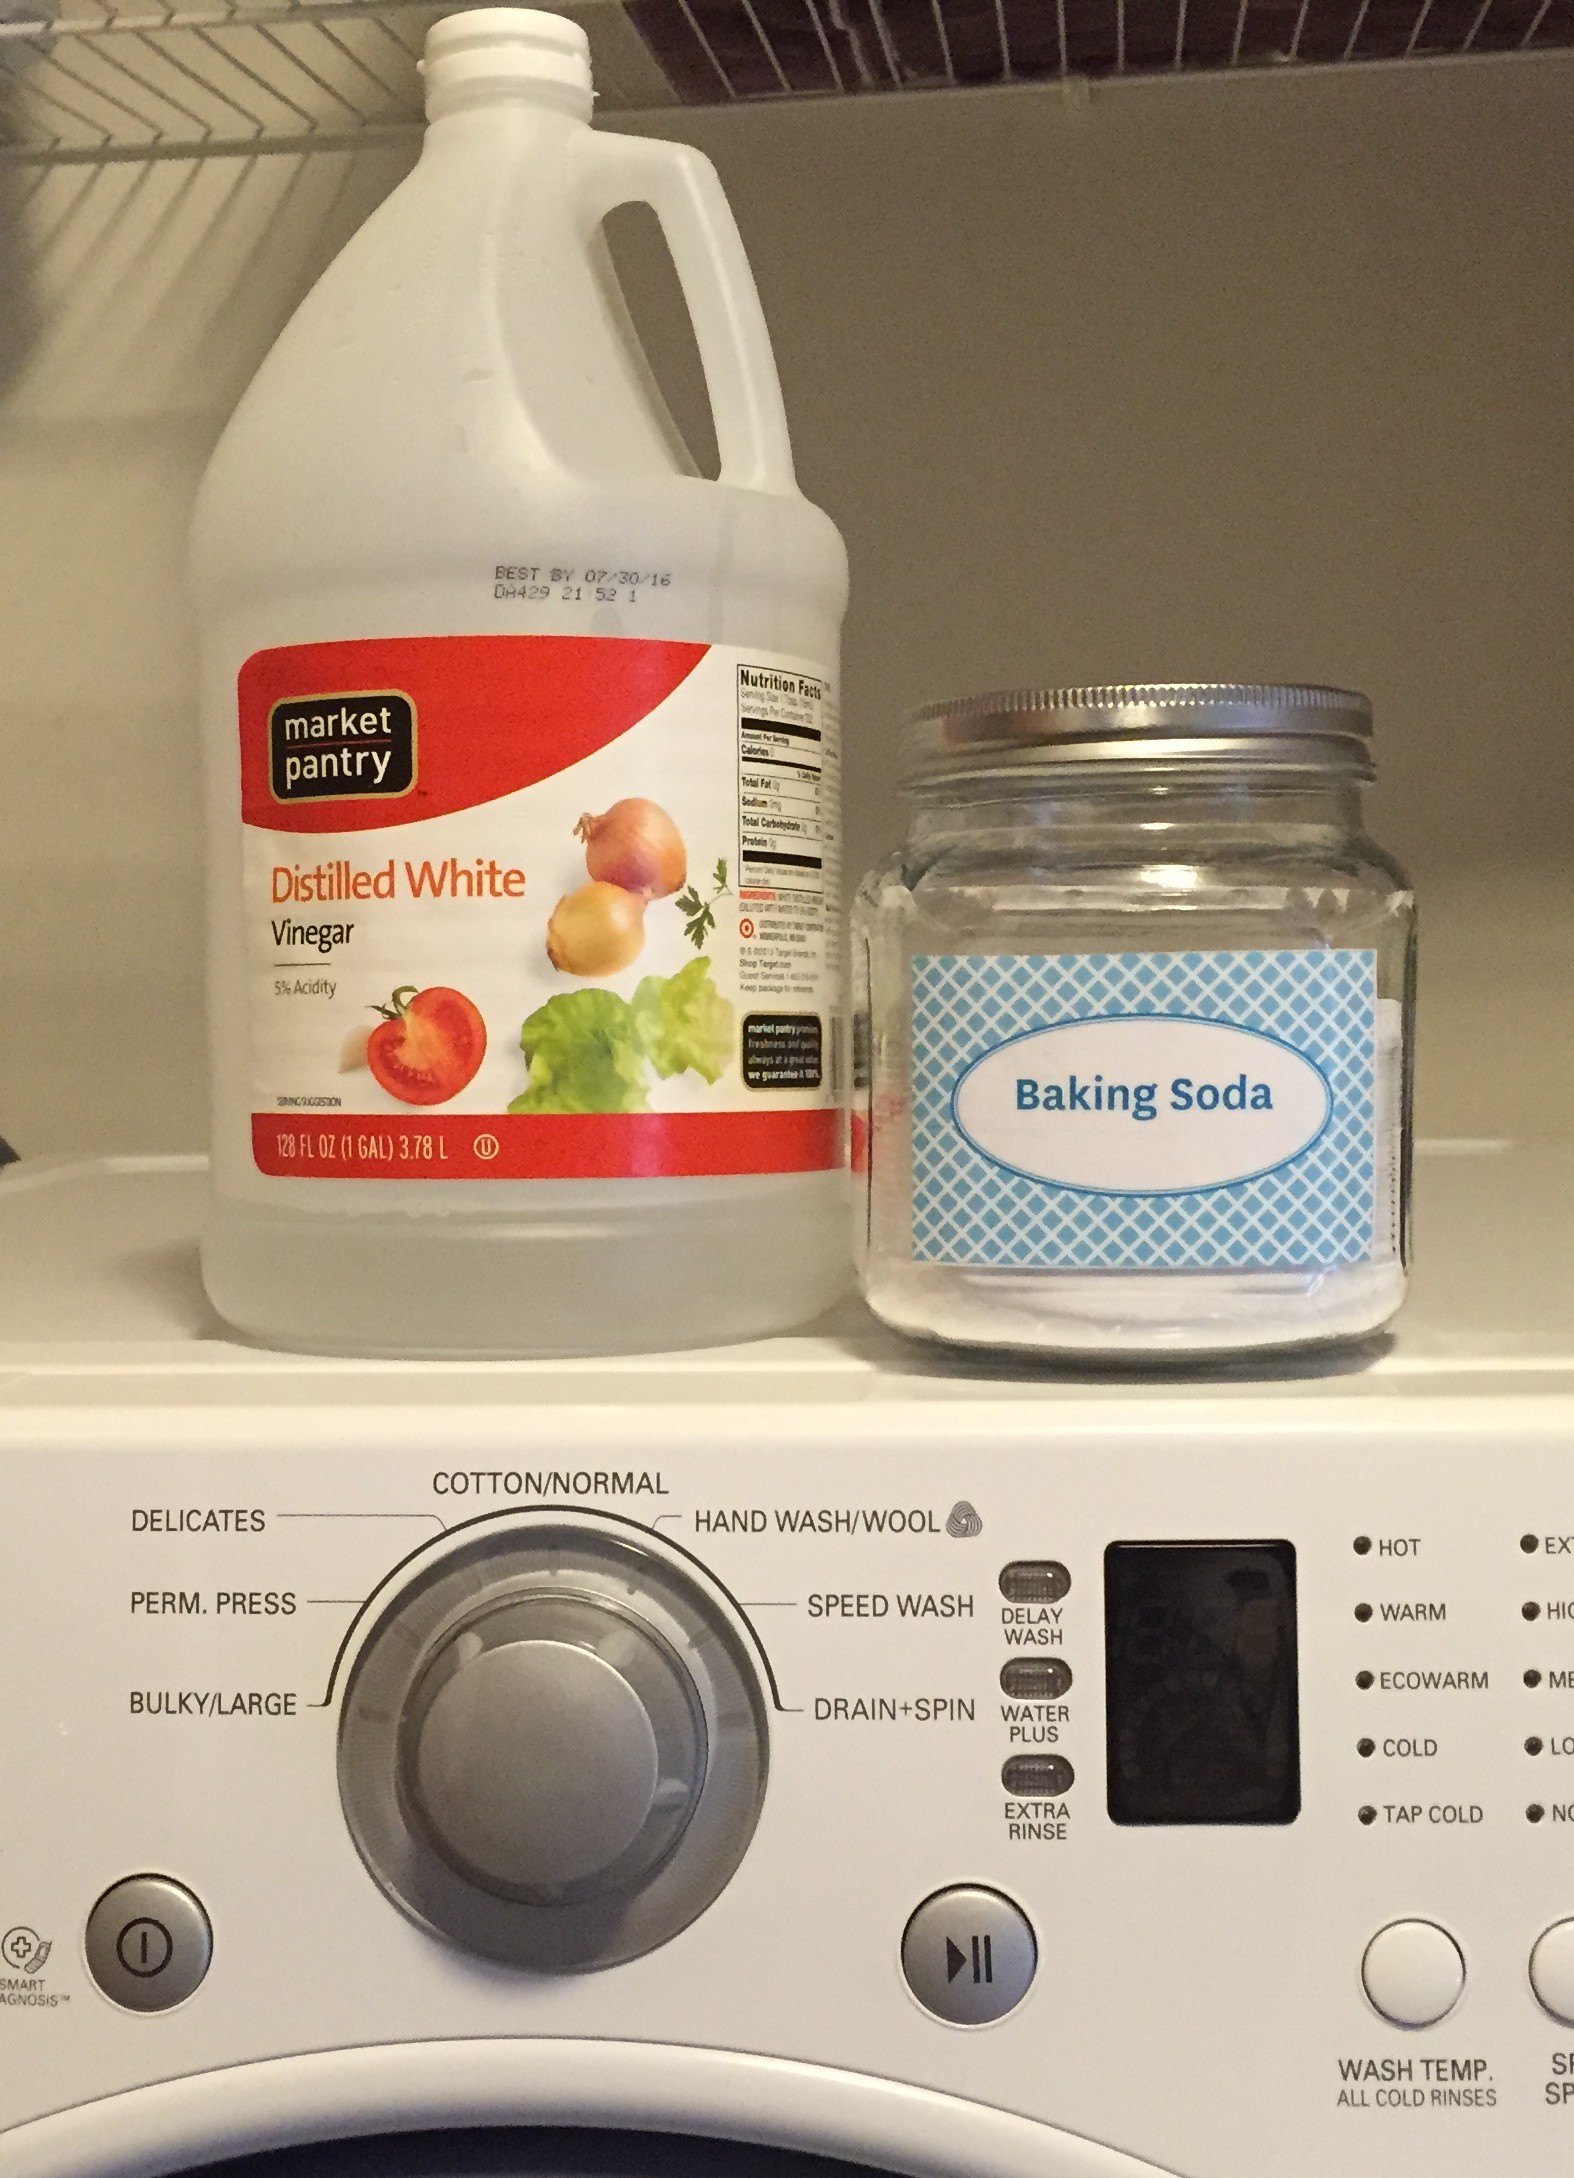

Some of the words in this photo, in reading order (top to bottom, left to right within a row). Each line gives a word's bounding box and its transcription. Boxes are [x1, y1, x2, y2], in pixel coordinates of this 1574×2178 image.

[495, 565, 540, 581] BEST
[550, 567, 575, 583] BY
[584, 569, 671, 587] 07/30/16
[561, 586, 582, 600] 21
[595, 587, 617, 602] 52
[629, 589, 636, 602] 1
[740, 669, 795, 693] Nutrition
[799, 679, 822, 700] Facts
[285, 707, 392, 740] market
[285, 749, 392, 790] pantry
[741, 776, 759, 788] Total
[761, 778, 772, 789] Fat
[742, 815, 760, 827] Total
[742, 835, 768, 847] Protein
[271, 859, 395, 903] Distilled
[404, 858, 526, 898] White
[271, 918, 354, 953] Vinegar
[274, 980, 291, 995] 5%
[293, 979, 337, 998] Acidity
[1016, 1075, 1158, 1121] Baking
[1170, 1074, 1273, 1111] Soda
[276, 1133, 296, 1158] 128
[300, 1134, 315, 1158] FL
[319, 1134, 336, 1159] OZ
[341, 1135, 352, 1161] (1
[358, 1135, 394, 1161] GAL)
[400, 1134, 433, 1160] 3.78
[439, 1135, 448, 1160] L
[432, 1471, 670, 1498] COTTON/NORMAL
[131, 1509, 266, 1532] DELICATES
[695, 1510, 767, 1533] HAND
[774, 1509, 941, 1535] WASH/WOOL
[1378, 1538, 1421, 1557] HOT
[1545, 1536, 1574, 1554] EX
[130, 1592, 208, 1615] PERM.
[216, 1592, 297, 1616] PRESS
[808, 1594, 889, 1617] SPEED
[897, 1595, 974, 1618] WASH
[1380, 1603, 1447, 1621] WARM
[1001, 1607, 1063, 1624] DELAY
[1004, 1629, 1063, 1645] WASH
[1380, 1671, 1489, 1690] ECOWARM
[130, 1691, 297, 1717] BULKY/LARGE
[814, 1698, 976, 1722] DRAIN+SPIN
[1001, 1705, 1069, 1722] WATER
[1009, 1726, 1059, 1743] PLUS
[1383, 1738, 1438, 1757] COLD
[1004, 1803, 1071, 1820] EXTRA
[1383, 1805, 1422, 1823] TAP
[1428, 1805, 1484, 1824] COLD
[1009, 1823, 1067, 1840] RINSE
[0, 1978, 46, 1991] SMART
[1338, 2059, 1413, 2082] WASH
[1420, 2059, 1494, 2082] TEMP.
[1337, 2089, 1370, 2107] ALL
[1375, 2089, 1425, 2107] COLD
[1430, 2089, 1497, 2107] RINSES
